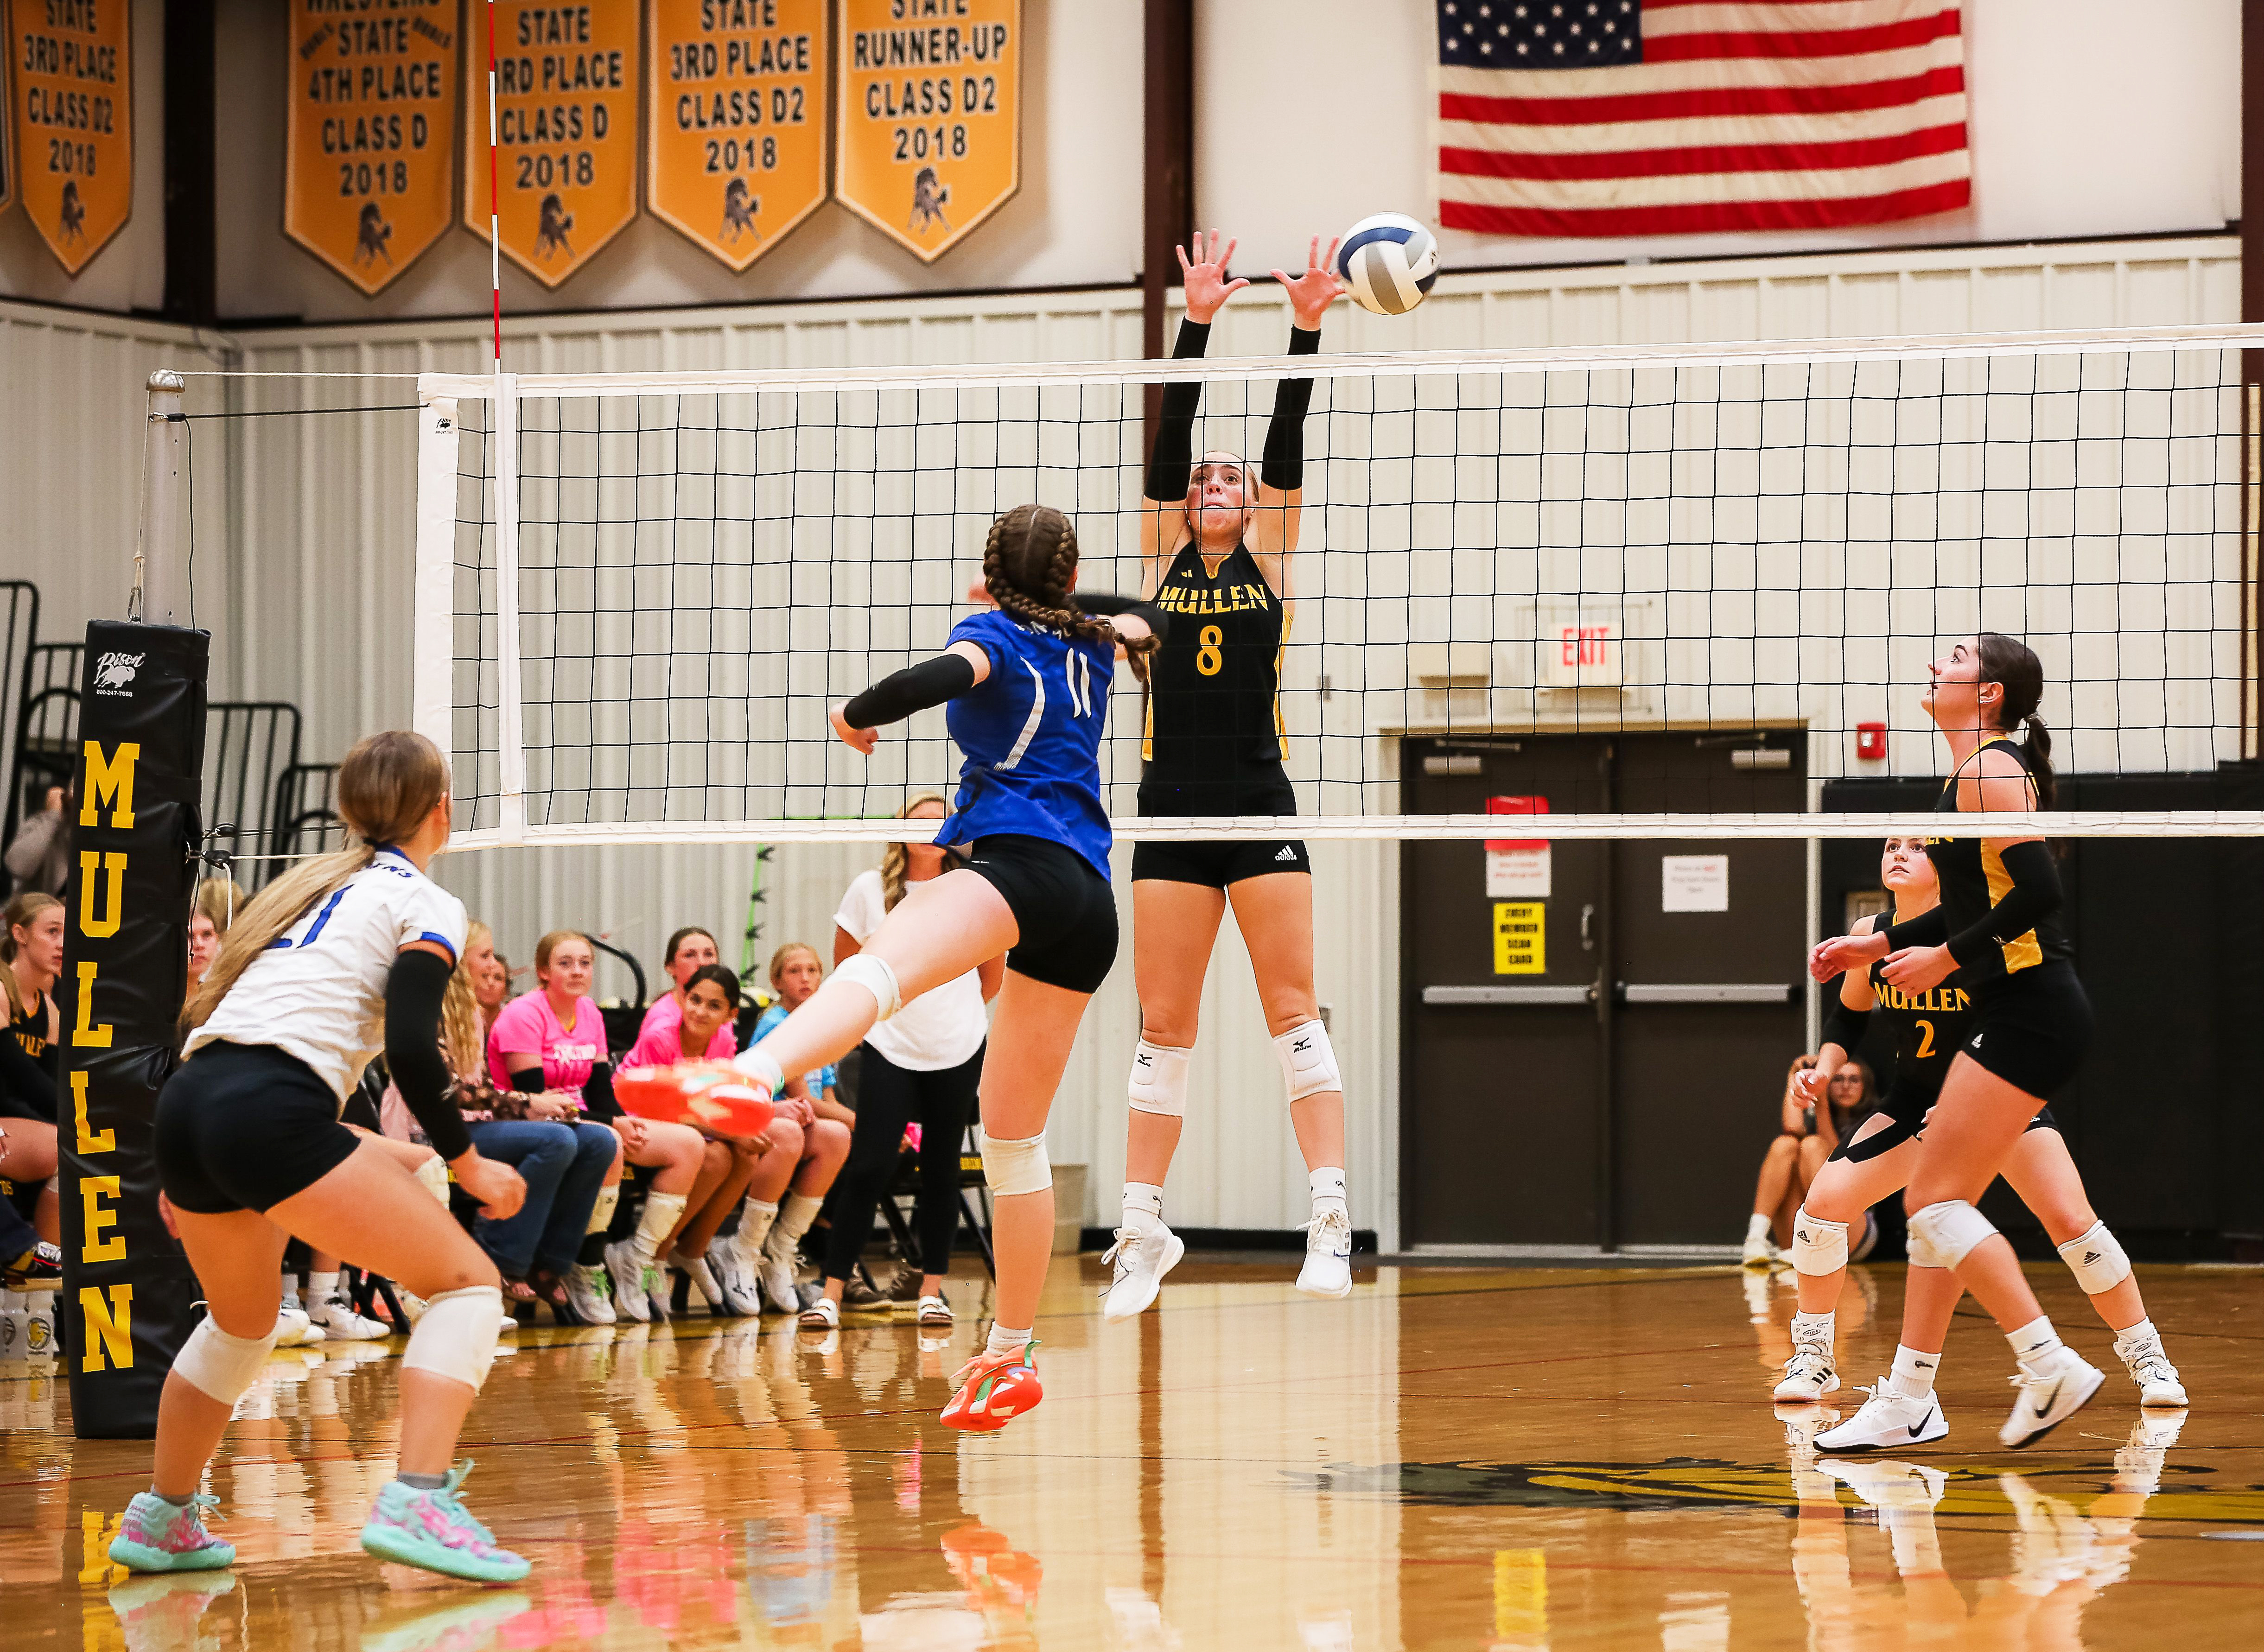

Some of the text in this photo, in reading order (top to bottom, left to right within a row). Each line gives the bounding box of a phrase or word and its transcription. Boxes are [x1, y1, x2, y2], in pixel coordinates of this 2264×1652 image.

[518, 7, 590, 45] STATE
[702, 0, 776, 31] STATE
[338, 18, 408, 56] STATE
[855, 26, 1006, 68] RUNNER-UP
[25, 34, 115, 83] 3RD PLACE
[543, 52, 622, 90] PLACE
[671, 36, 809, 81] 3RD PLACE
[309, 62, 440, 103] 4TH PLACE
[866, 76, 997, 118] CLASS D2
[28, 87, 113, 133] CLASS D2
[501, 103, 609, 145] CLASS D
[677, 87, 804, 130] CLASS D2
[322, 114, 427, 154] CLASS D
[895, 127, 967, 160] 2018
[50, 139, 96, 176] 2018
[516, 152, 594, 189] 2018
[706, 137, 776, 172] 2018
[340, 160, 407, 197] 2018
[1157, 585, 1268, 614] MULLEN
[1197, 625, 1222, 675] 8
[1562, 627, 1609, 666] EXIT
[1066, 648, 1091, 718] 11
[69, 740, 140, 1373] MULLEN
[1915, 1020, 1936, 1058] 2
